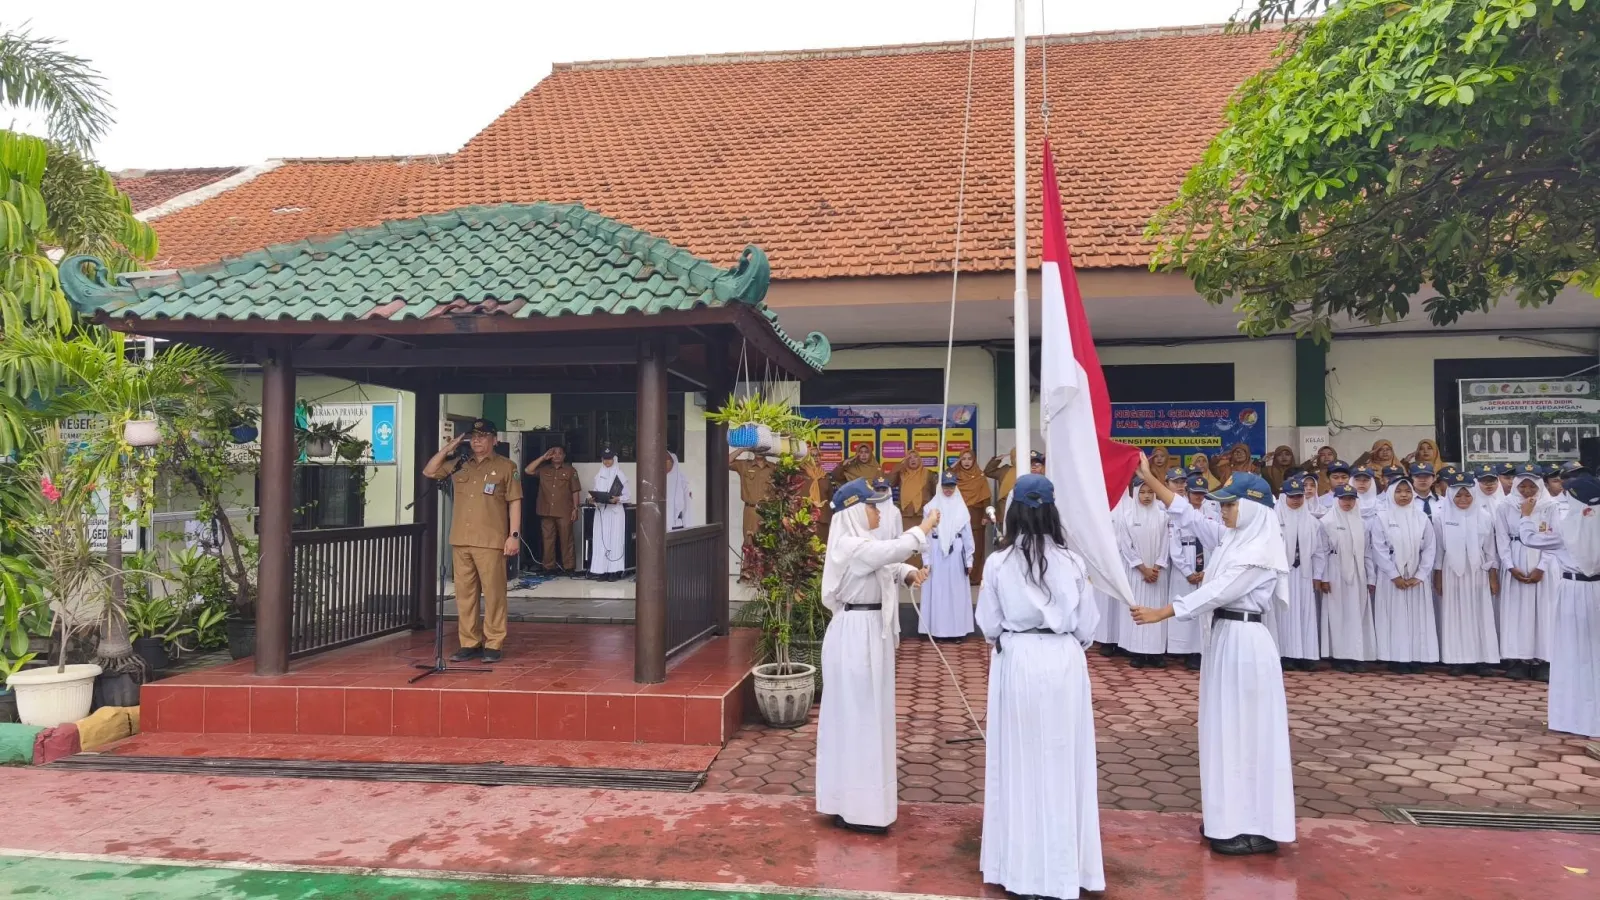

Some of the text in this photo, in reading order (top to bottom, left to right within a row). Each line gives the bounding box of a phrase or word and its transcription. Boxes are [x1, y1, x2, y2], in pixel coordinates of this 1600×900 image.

[1114, 409, 1156, 418] NEGERI
[1168, 408, 1229, 418] GEDANGAN
[1144, 419, 1200, 429] SIDOARJO
